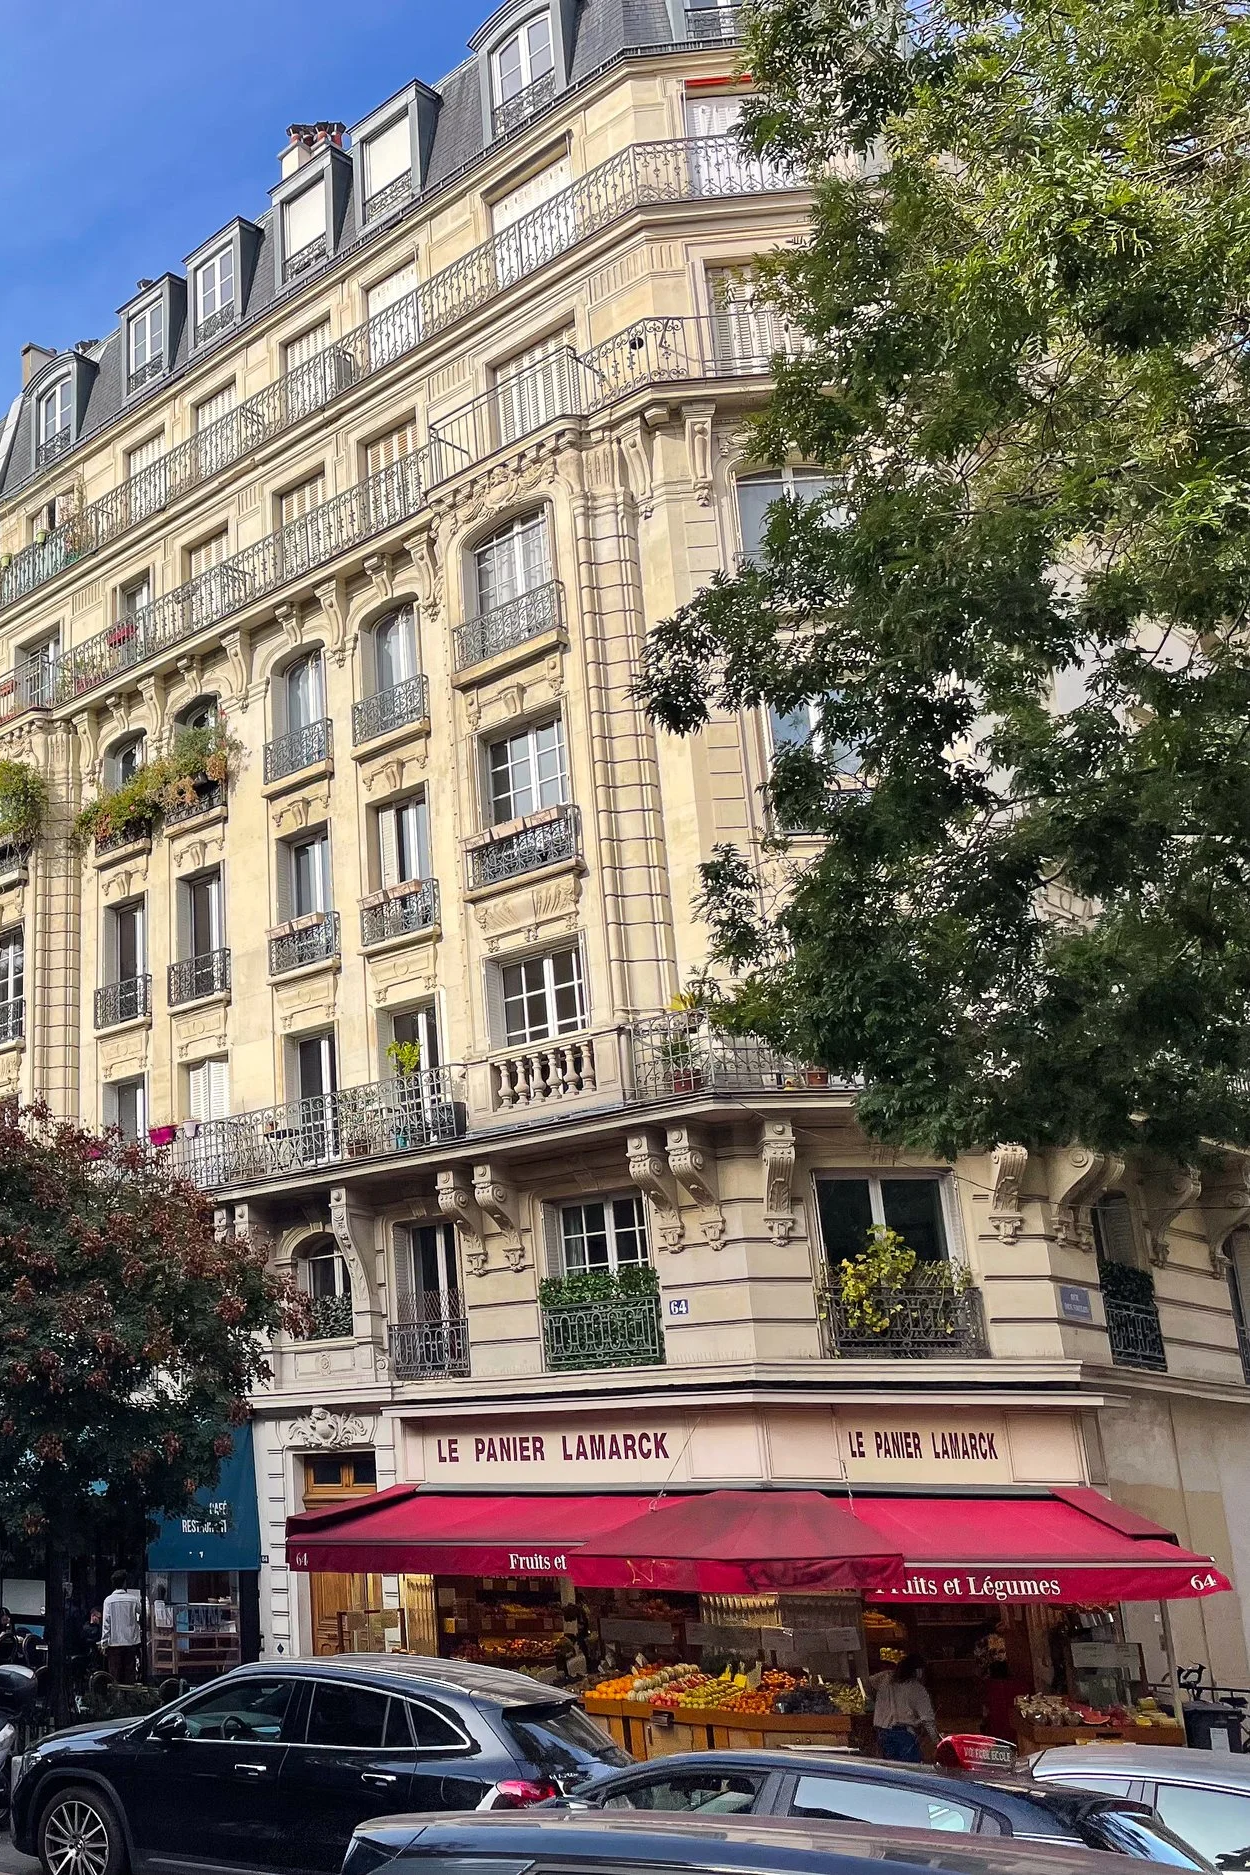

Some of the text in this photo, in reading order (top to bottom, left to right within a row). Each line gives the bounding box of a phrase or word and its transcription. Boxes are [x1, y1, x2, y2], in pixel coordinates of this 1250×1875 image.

[670, 1300, 687, 1315] 64
[437, 1432, 670, 1463] LE PANIER LAMARCK
[848, 1431, 999, 1460] LE PANIER LAMARCK
[209, 1500, 228, 1516] CAFÉ
[181, 1519, 228, 1533] RESTURT
[295, 1552, 309, 1567] 64
[508, 1553, 568, 1570] Fruits et
[875, 1574, 1062, 1601] uits et Légumes
[1189, 1573, 1217, 1592] 64
